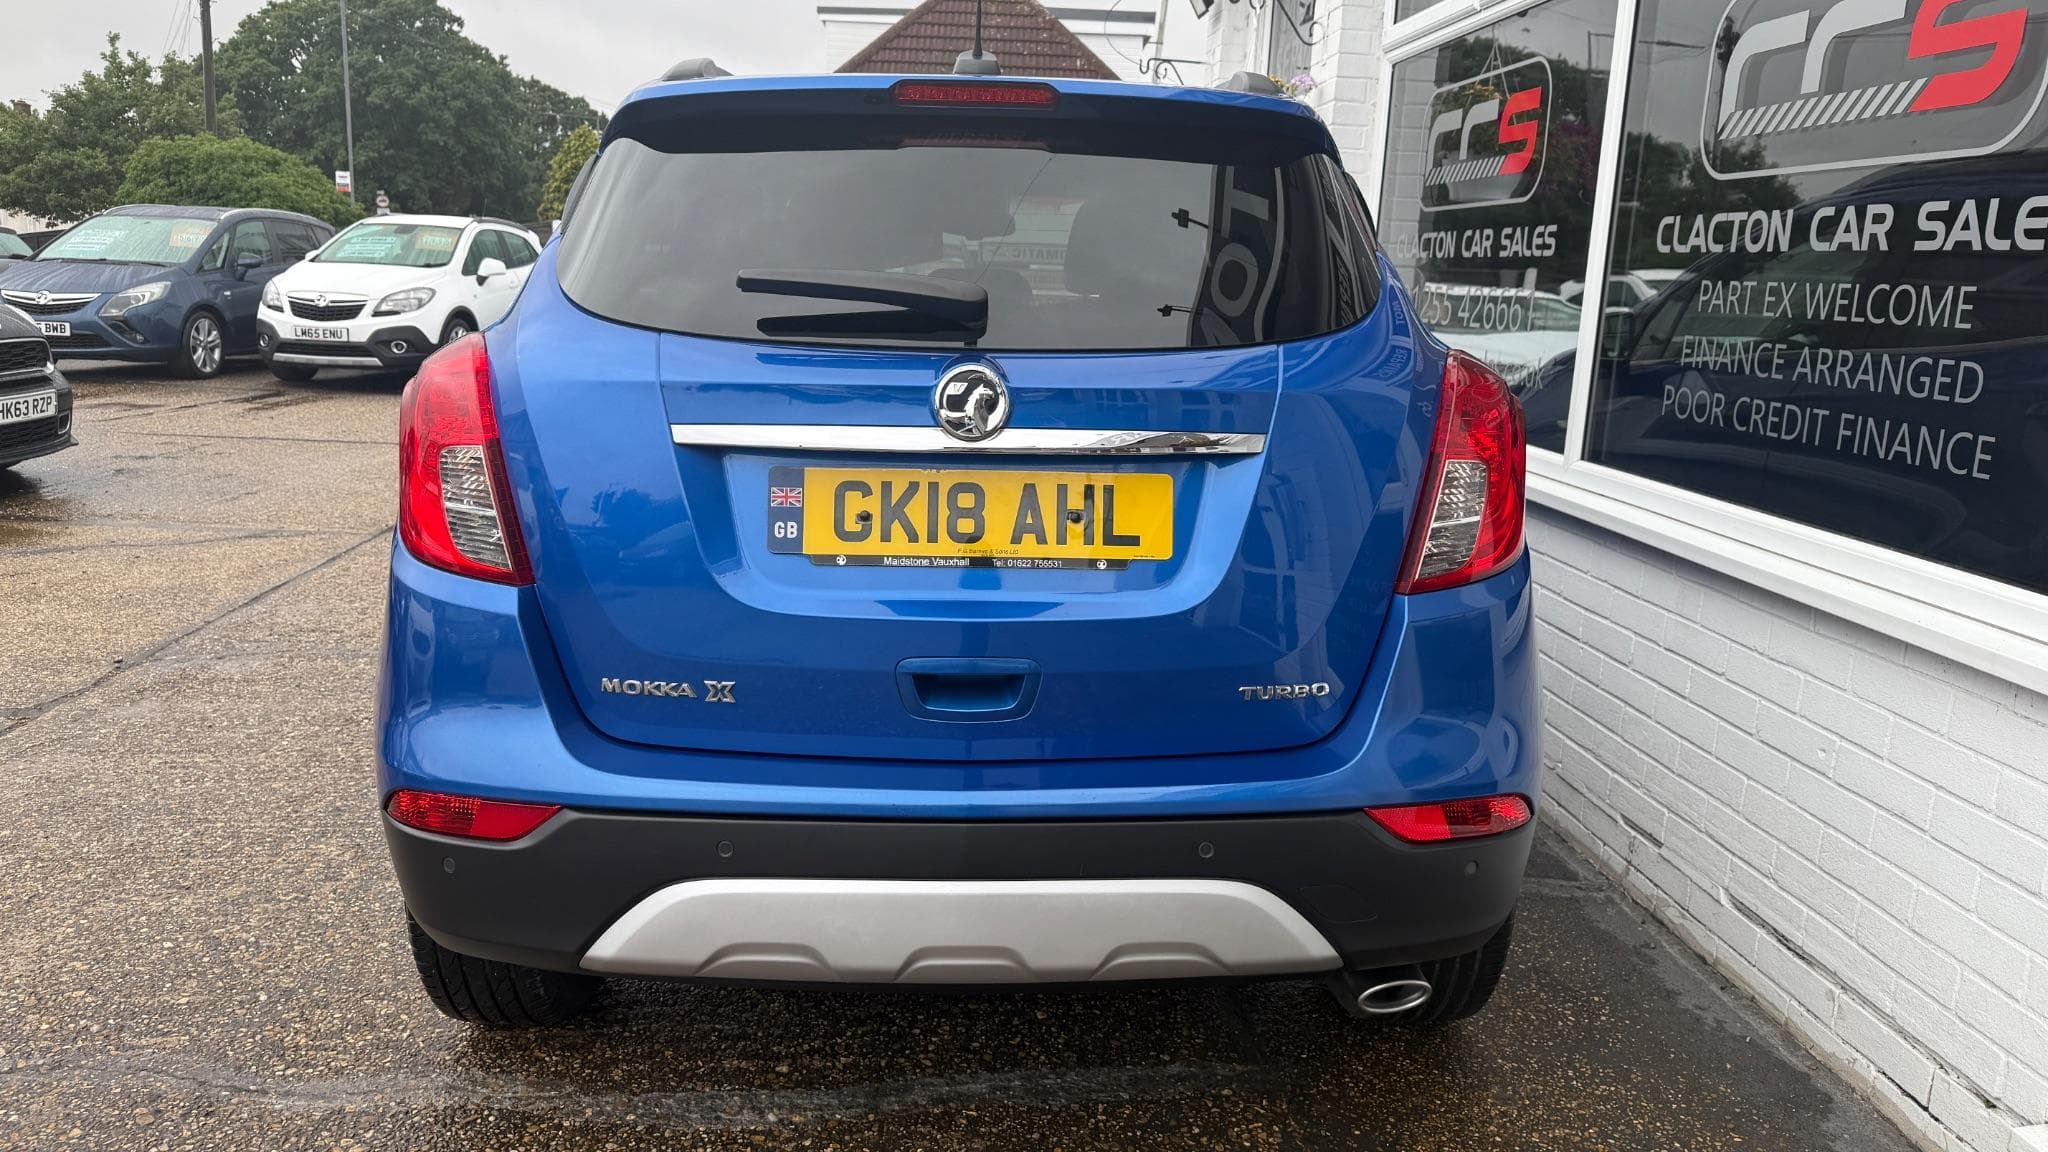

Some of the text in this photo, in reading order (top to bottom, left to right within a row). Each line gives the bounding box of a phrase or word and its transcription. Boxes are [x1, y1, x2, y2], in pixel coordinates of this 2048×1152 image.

[1397, 224, 1558, 258] CLACTON CAR SALES
[1656, 196, 2048, 253] CLACTON CAR SALE
[1458, 286, 1536, 332] 426661
[1698, 280, 1977, 329] PART EX WELCOME
[294, 327, 343, 340] LM65 ENU
[1681, 335, 1985, 404] FINANCE ARRANGED
[32, 396, 52, 415] RZP
[1661, 385, 1996, 480] POOR CREDIT FINANCE
[774, 521, 798, 538] GB
[834, 480, 1141, 547] GK18 AHL
[883, 556, 930, 566] Maidstone
[932, 557, 970, 566] Vauxhall
[1007, 559, 1032, 568] 01622
[1034, 559, 1062, 568] 755531
[601, 677, 736, 703] MOKKA X
[1239, 682, 1330, 701] TURBO
